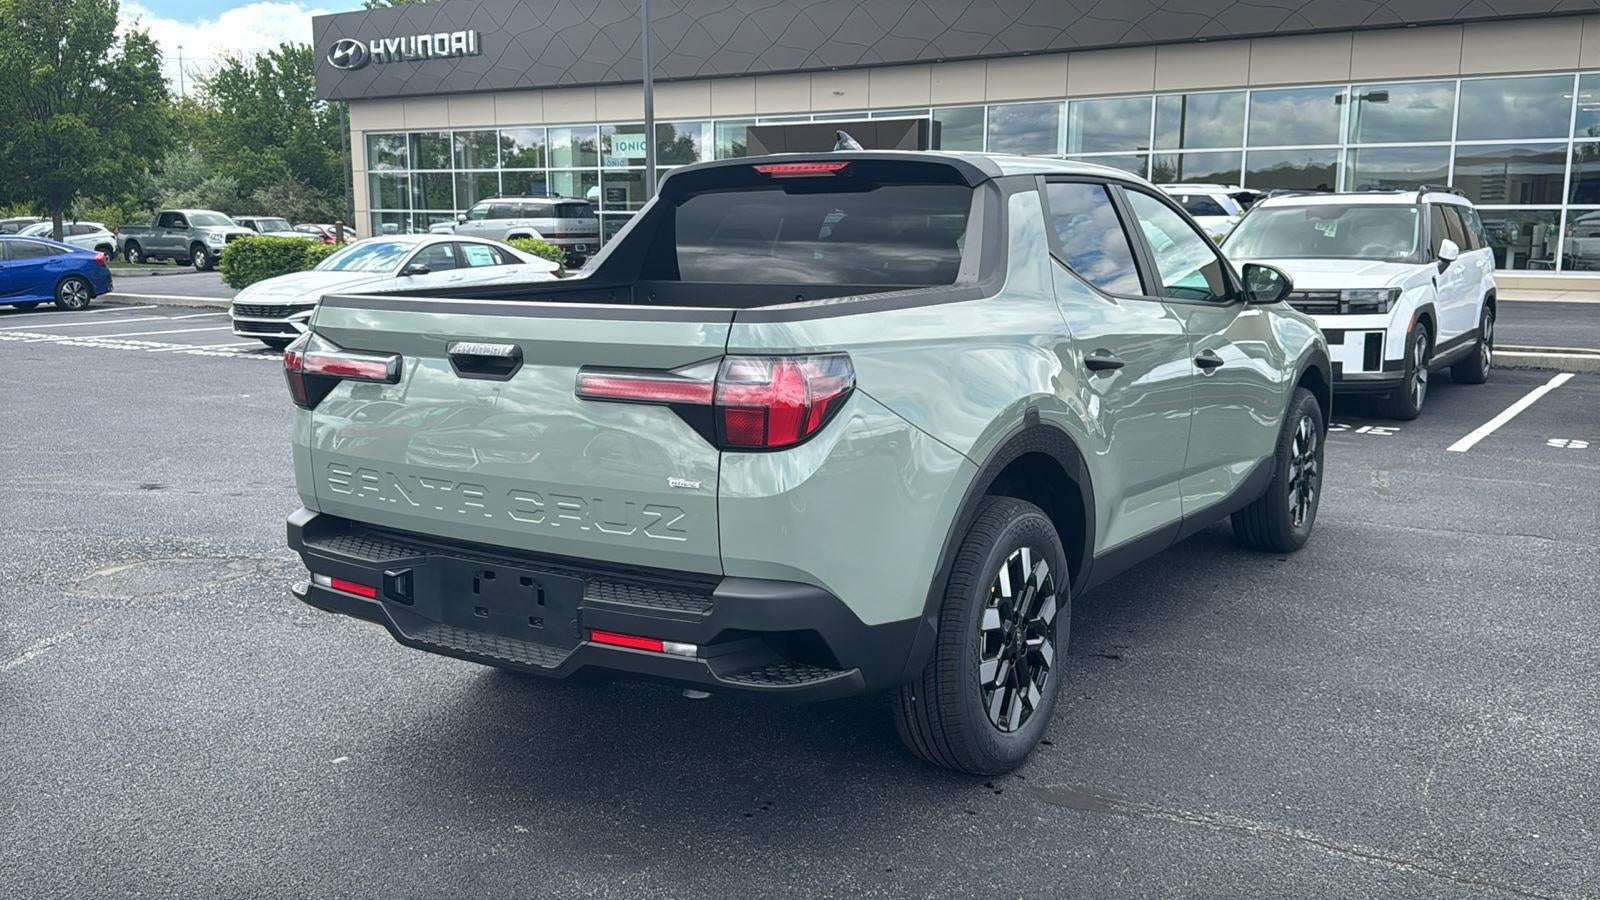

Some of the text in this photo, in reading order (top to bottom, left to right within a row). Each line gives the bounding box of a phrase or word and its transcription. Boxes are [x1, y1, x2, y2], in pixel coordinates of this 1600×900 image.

[370, 30, 478, 63] HYUNDAI
[455, 343, 505, 356] HYUNDAI
[327, 462, 688, 542] SANTA CRUZ
